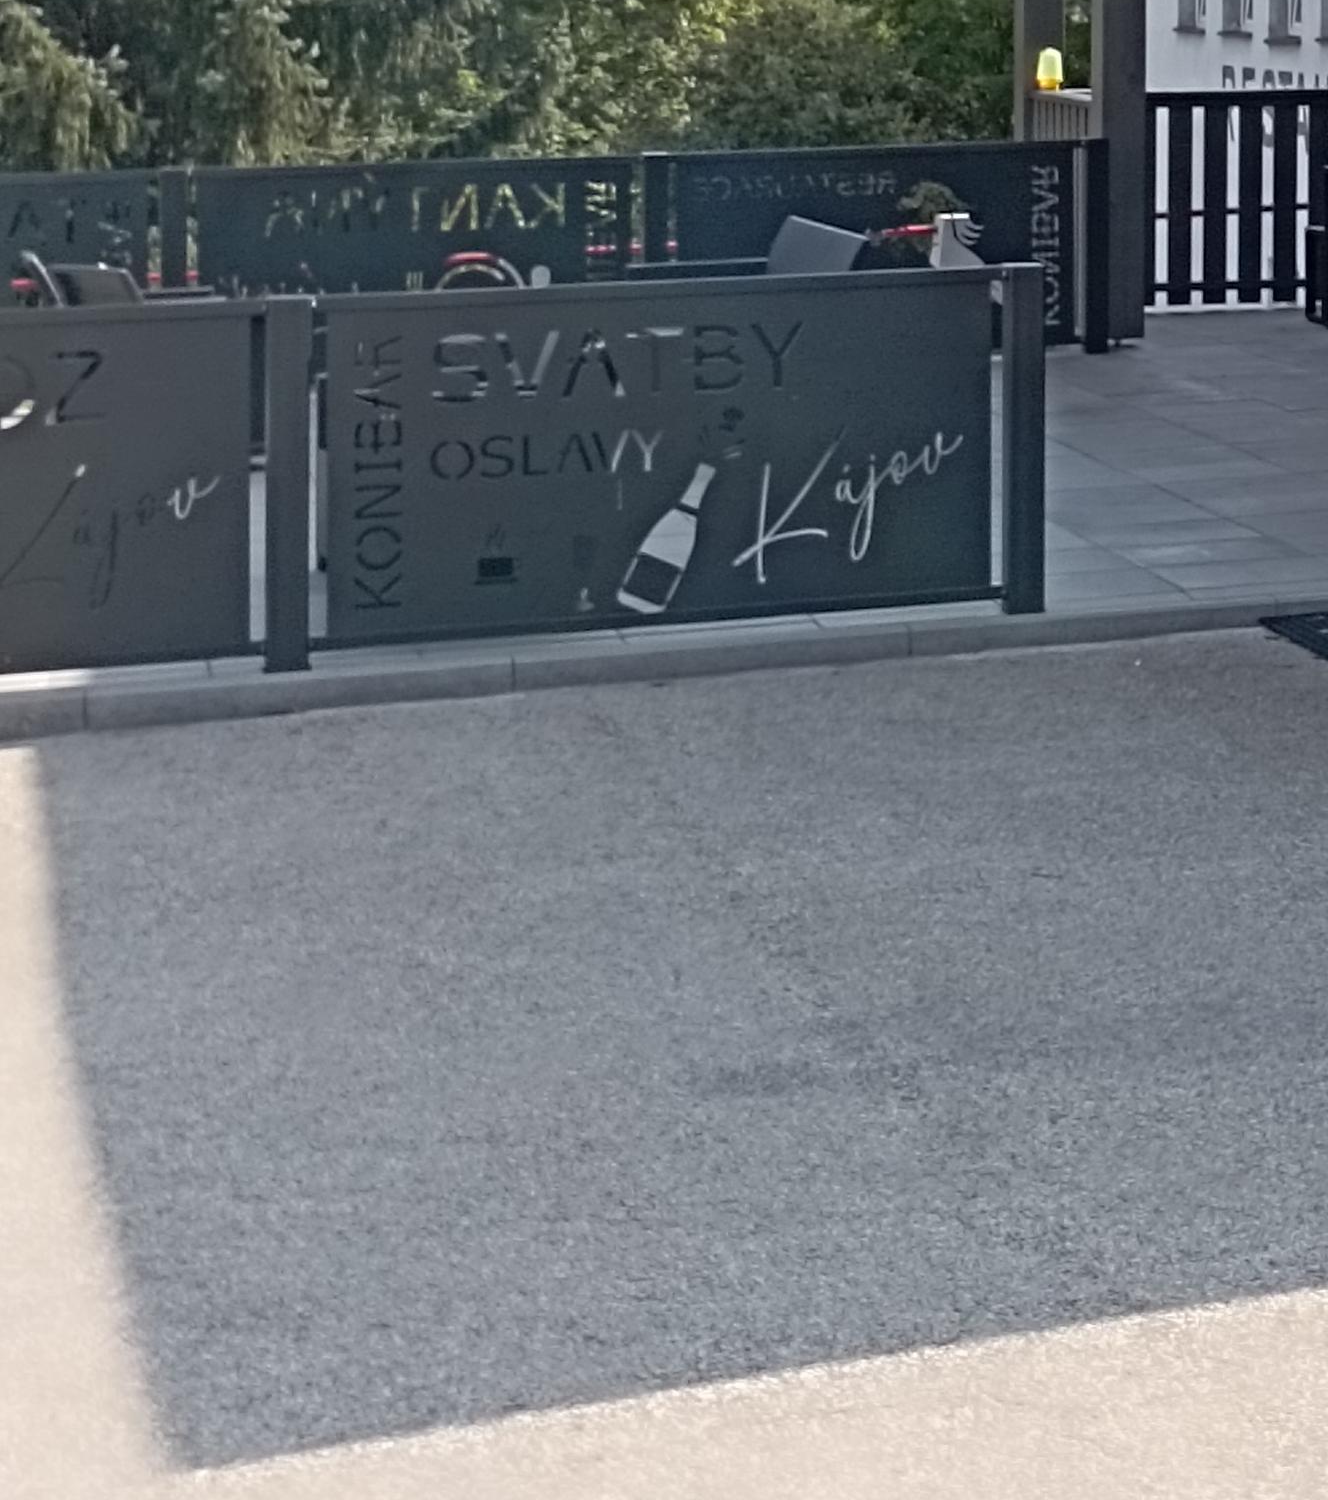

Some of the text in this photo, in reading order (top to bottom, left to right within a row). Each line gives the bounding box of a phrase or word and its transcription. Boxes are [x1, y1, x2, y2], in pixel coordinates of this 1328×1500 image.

[432, 321, 803, 402] SVATBY
[353, 335, 402, 611] KONIBAR
[430, 429, 663, 480] OSLAVY
[733, 425, 963, 583] Kájov
